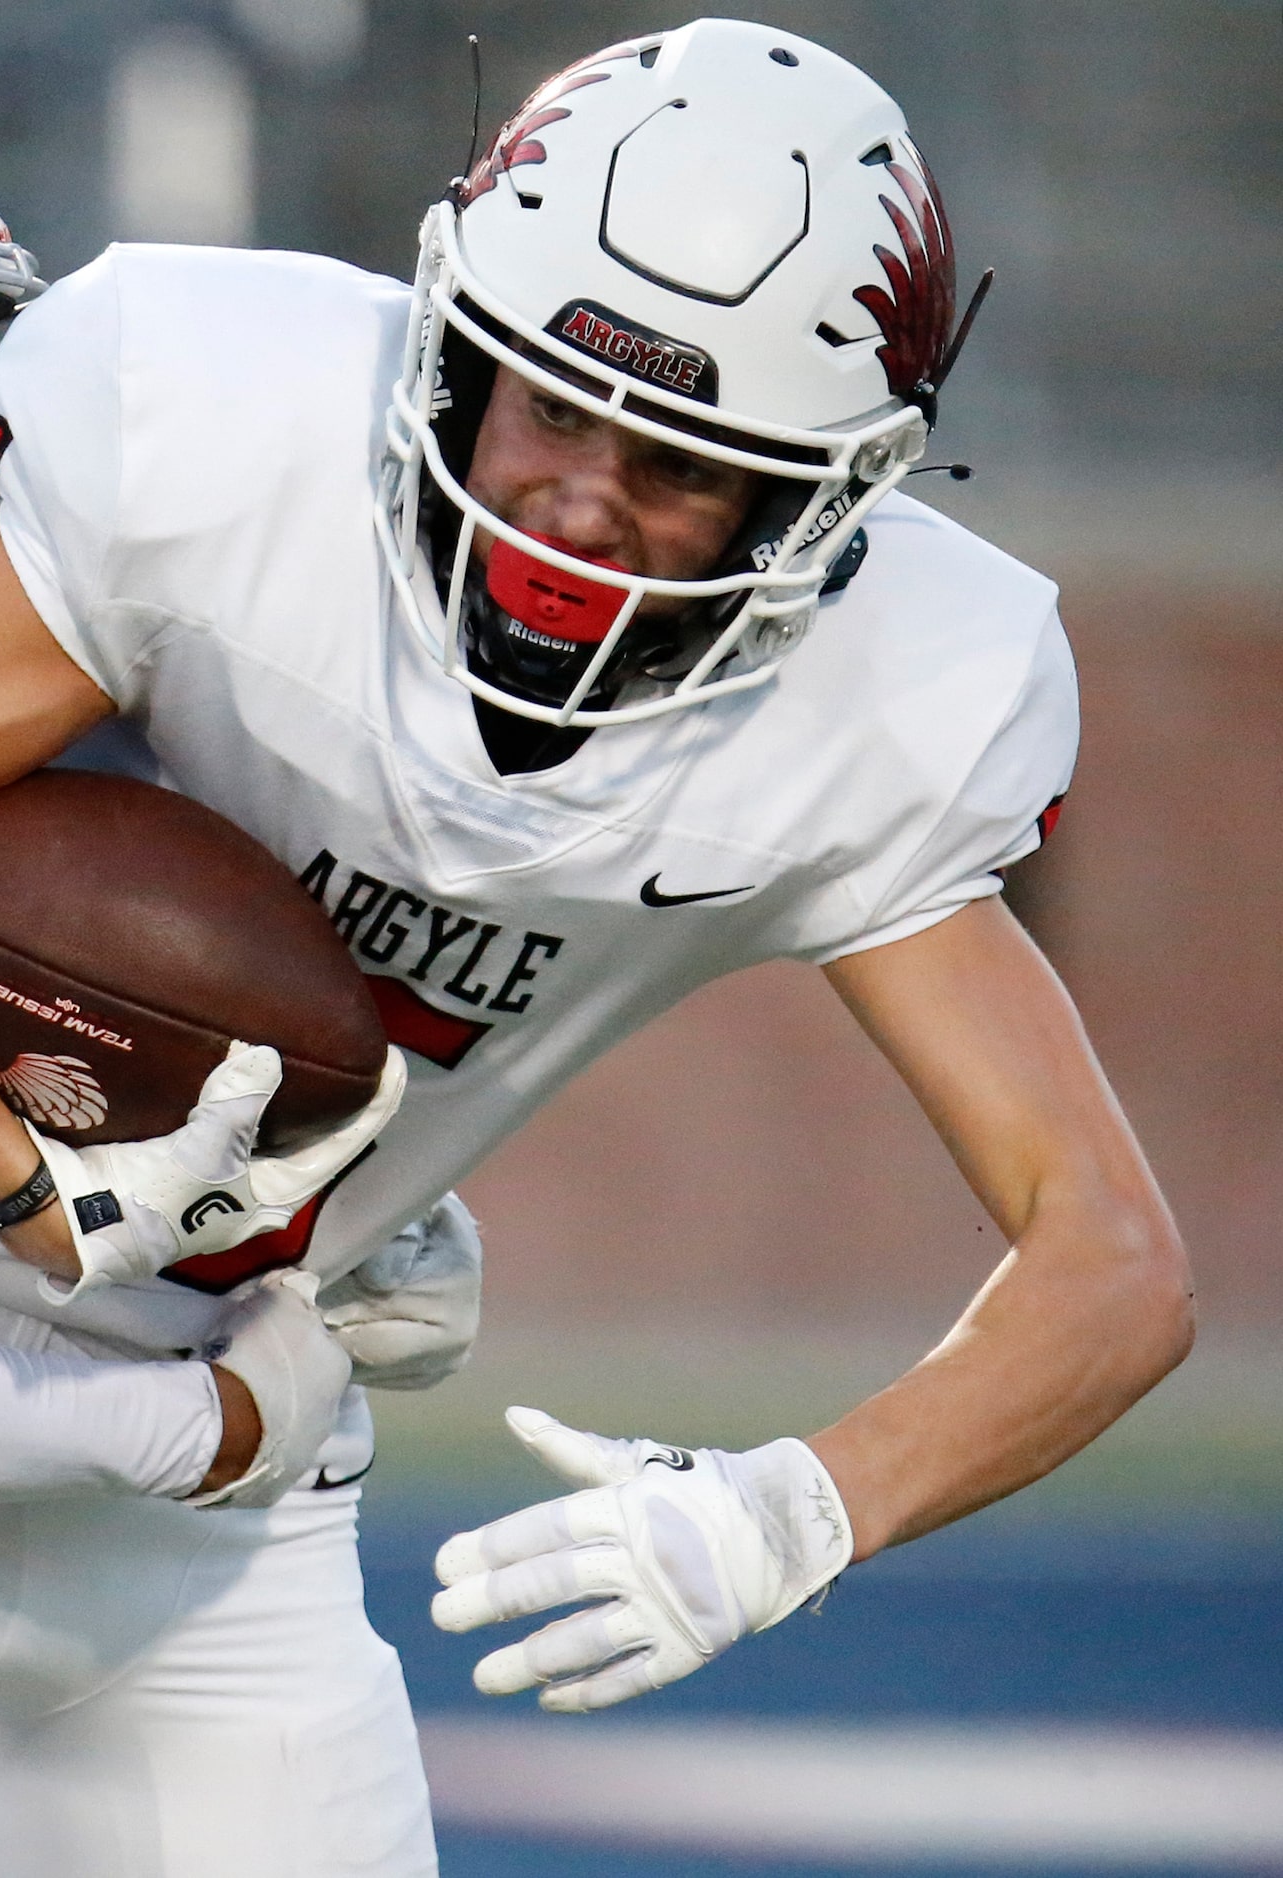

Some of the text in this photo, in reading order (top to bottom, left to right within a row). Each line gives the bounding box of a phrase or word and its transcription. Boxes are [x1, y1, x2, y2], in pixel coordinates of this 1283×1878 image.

[562, 306, 705, 393] ARGYLE
[298, 848, 564, 1013] ARGYLE
[64, 1016, 133, 1051] TEAM
